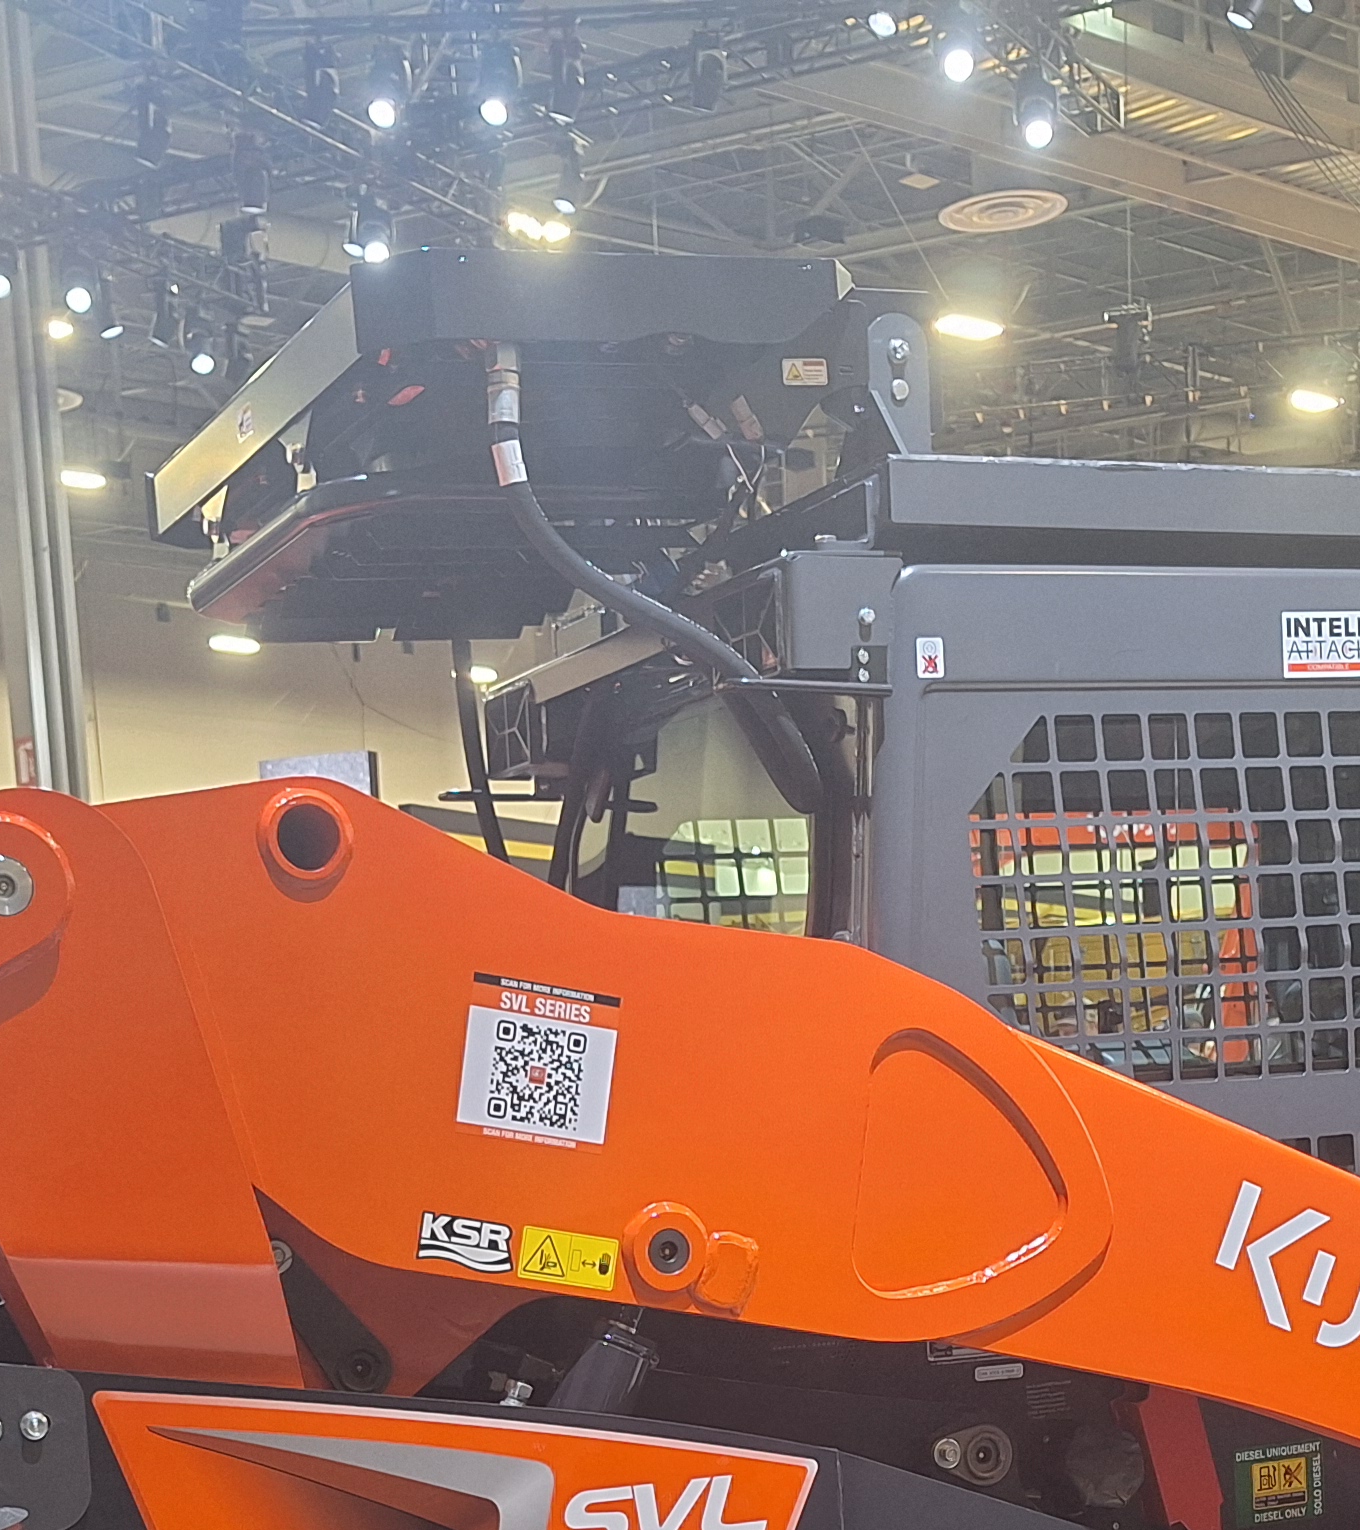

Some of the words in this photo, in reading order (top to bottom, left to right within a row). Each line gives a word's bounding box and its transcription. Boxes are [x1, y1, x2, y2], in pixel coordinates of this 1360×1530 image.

[500, 978, 518, 988] SCAN
[519, 981, 532, 990] FOR
[533, 984, 551, 994] MORE
[552, 987, 595, 1002] INFORMATION
[500, 991, 531, 1013] SVL
[534, 997, 591, 1022] SERIES
[420, 1211, 511, 1251] KSR
[1236, 1450, 1265, 1462] DIESEL
[1266, 1442, 1321, 1457] UNIQUEMENT
[1312, 1453, 1322, 1488] DIESEL
[1254, 1511, 1283, 1523] DIESEL
[1285, 1506, 1307, 1519] ONLY
[1313, 1489, 1323, 1515] SOLO
